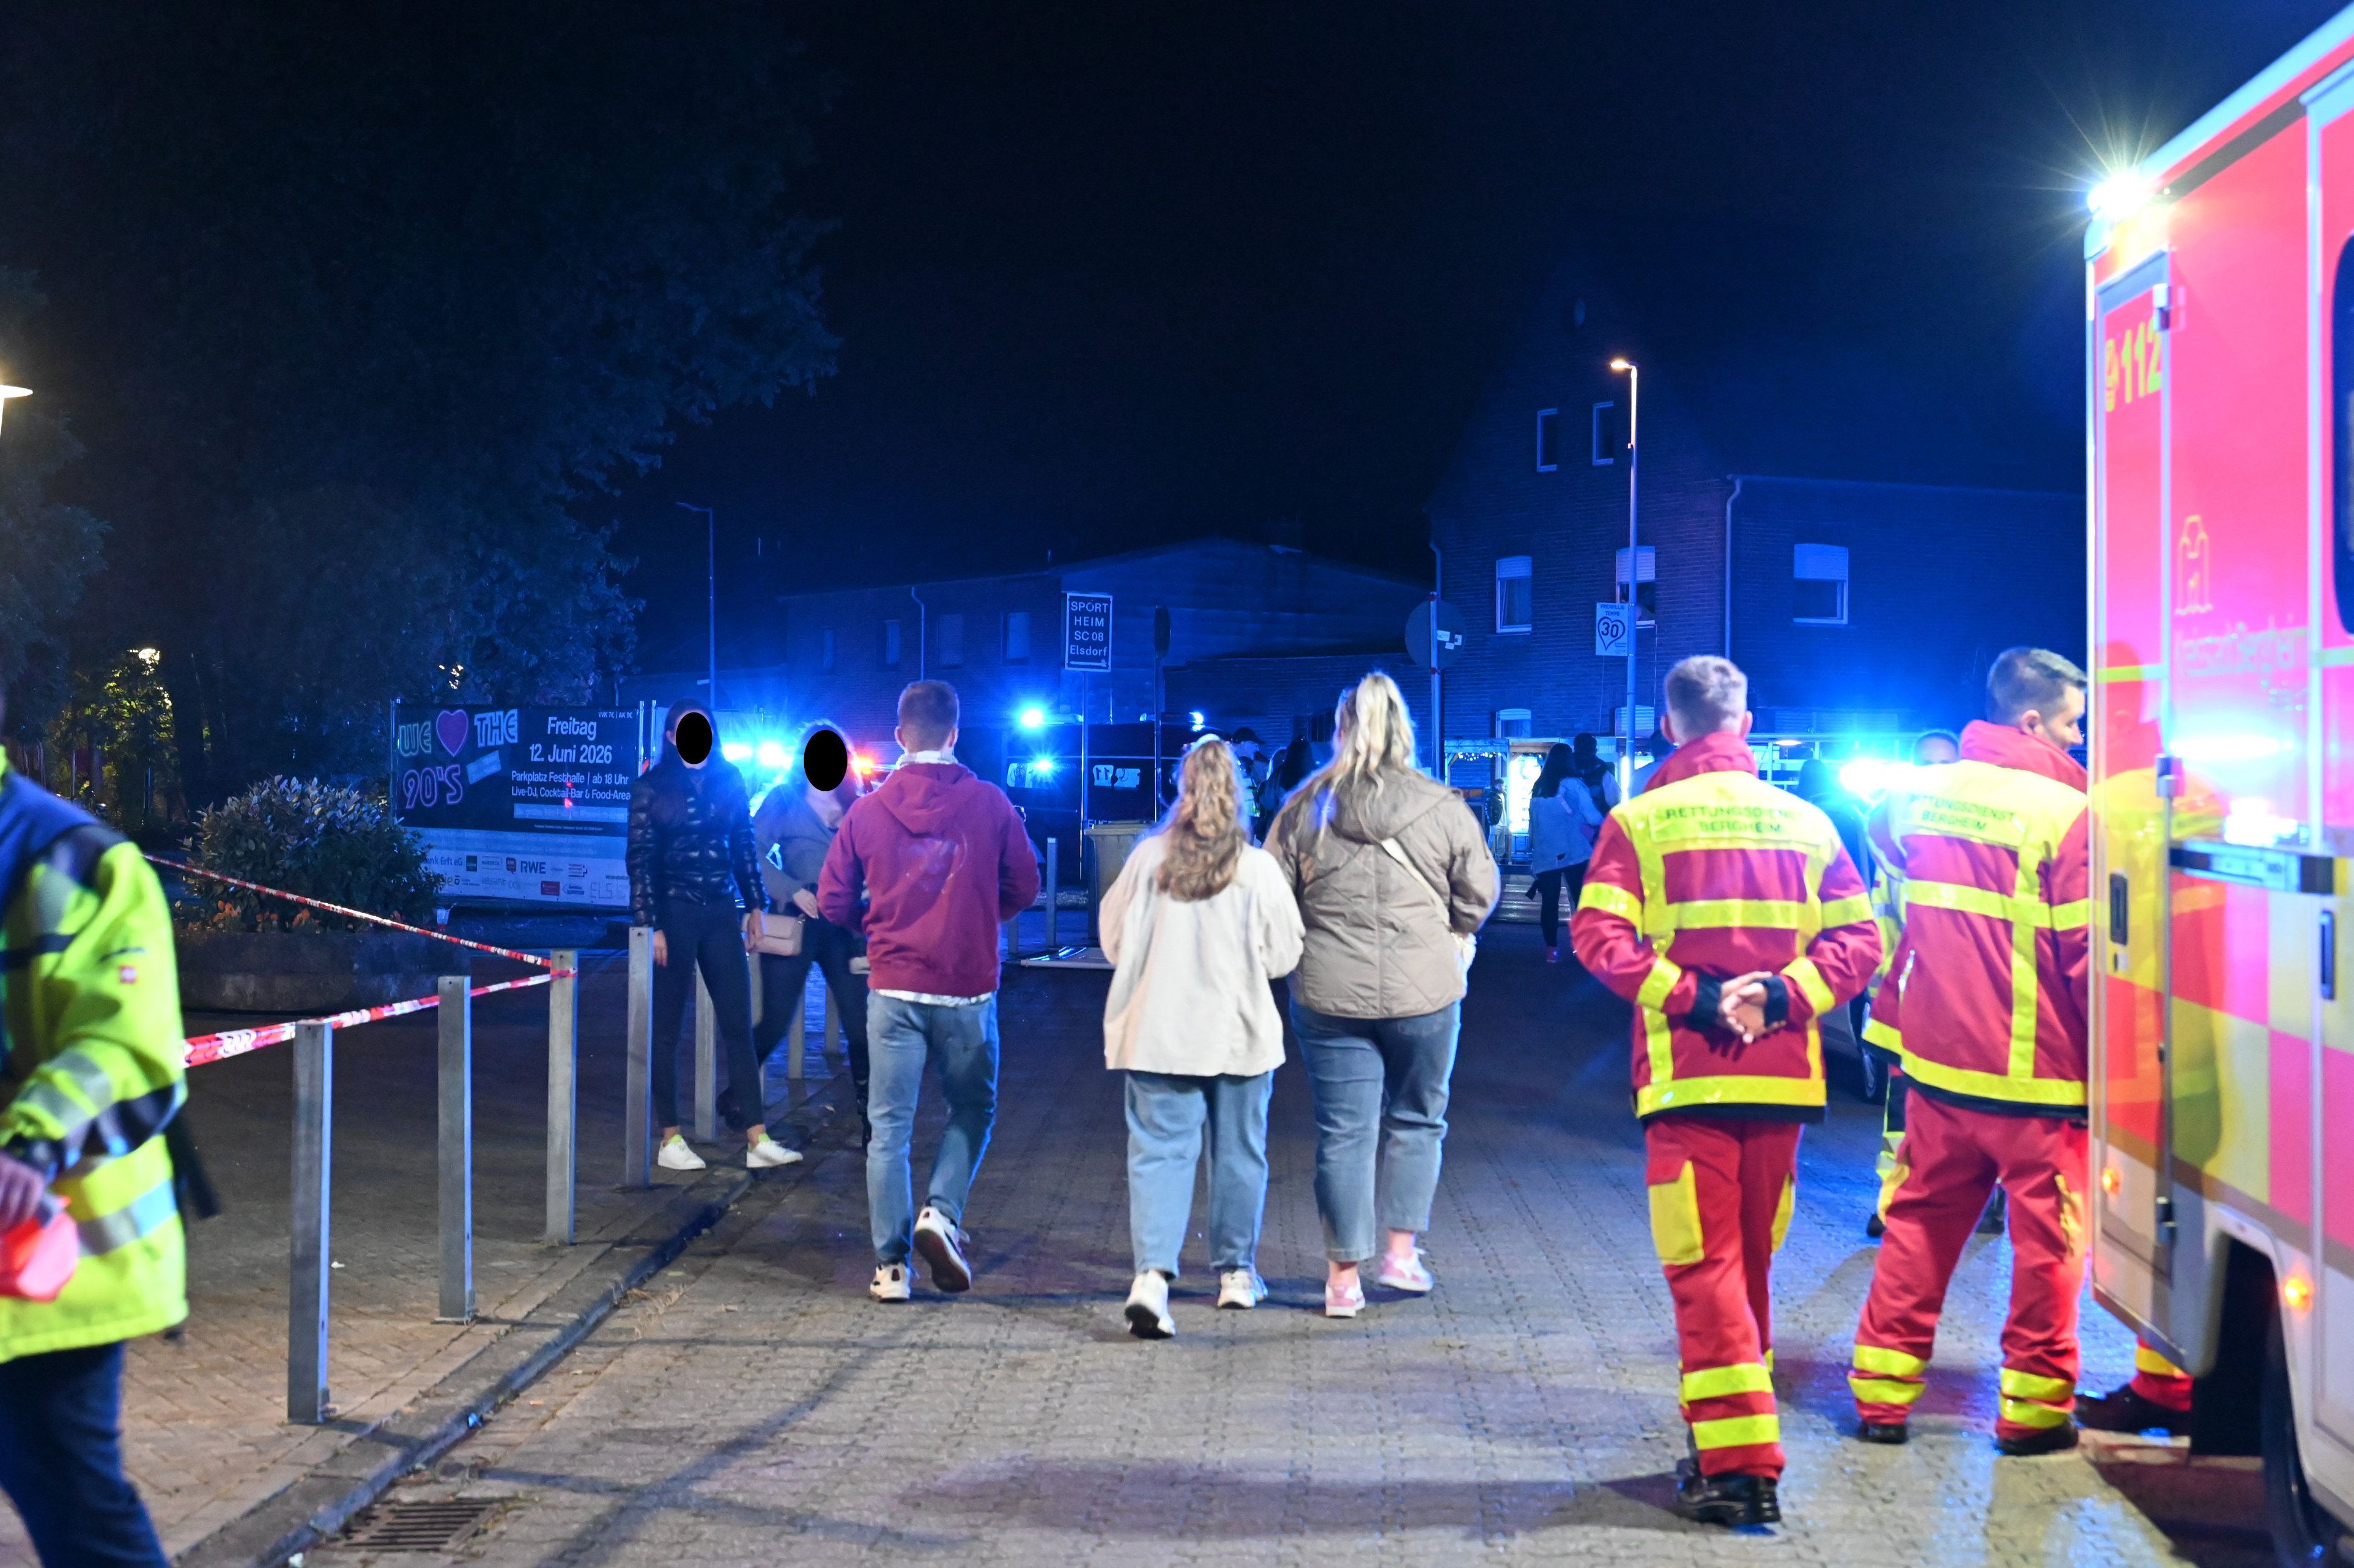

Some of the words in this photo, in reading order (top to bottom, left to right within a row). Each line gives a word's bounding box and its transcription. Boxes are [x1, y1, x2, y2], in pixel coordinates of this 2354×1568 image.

[2121, 318, 2162, 404] 112
[1071, 601, 1108, 613] SPORT
[1074, 616, 1104, 627] HEIM
[1074, 631, 1089, 641] SC
[1092, 632, 1104, 642] 08
[1601, 621, 1619, 638] 30
[1070, 645, 1108, 656] Elsdorf
[399, 721, 432, 757] WE
[473, 709, 518, 748] THE
[547, 716, 597, 741] Freitag
[530, 743, 544, 762] 12.
[547, 744, 577, 763] Juni
[579, 744, 612, 764] 2026
[511, 771, 547, 785] Parkplatz
[549, 771, 585, 783] Festhalle
[592, 773, 602, 784] ab
[604, 773, 612, 785] 18
[614, 774, 629, 785] Uhr
[402, 764, 463, 809] 90'S
[511, 786, 539, 798] Live-DJ,
[539, 787, 583, 799] Cocktail-Bar
[585, 789, 590, 799] &
[591, 789, 631, 801] Food-Area
[1699, 820, 1782, 833] BERGHEM
[440, 856, 453, 866] Erft
[520, 860, 546, 875] RWE
